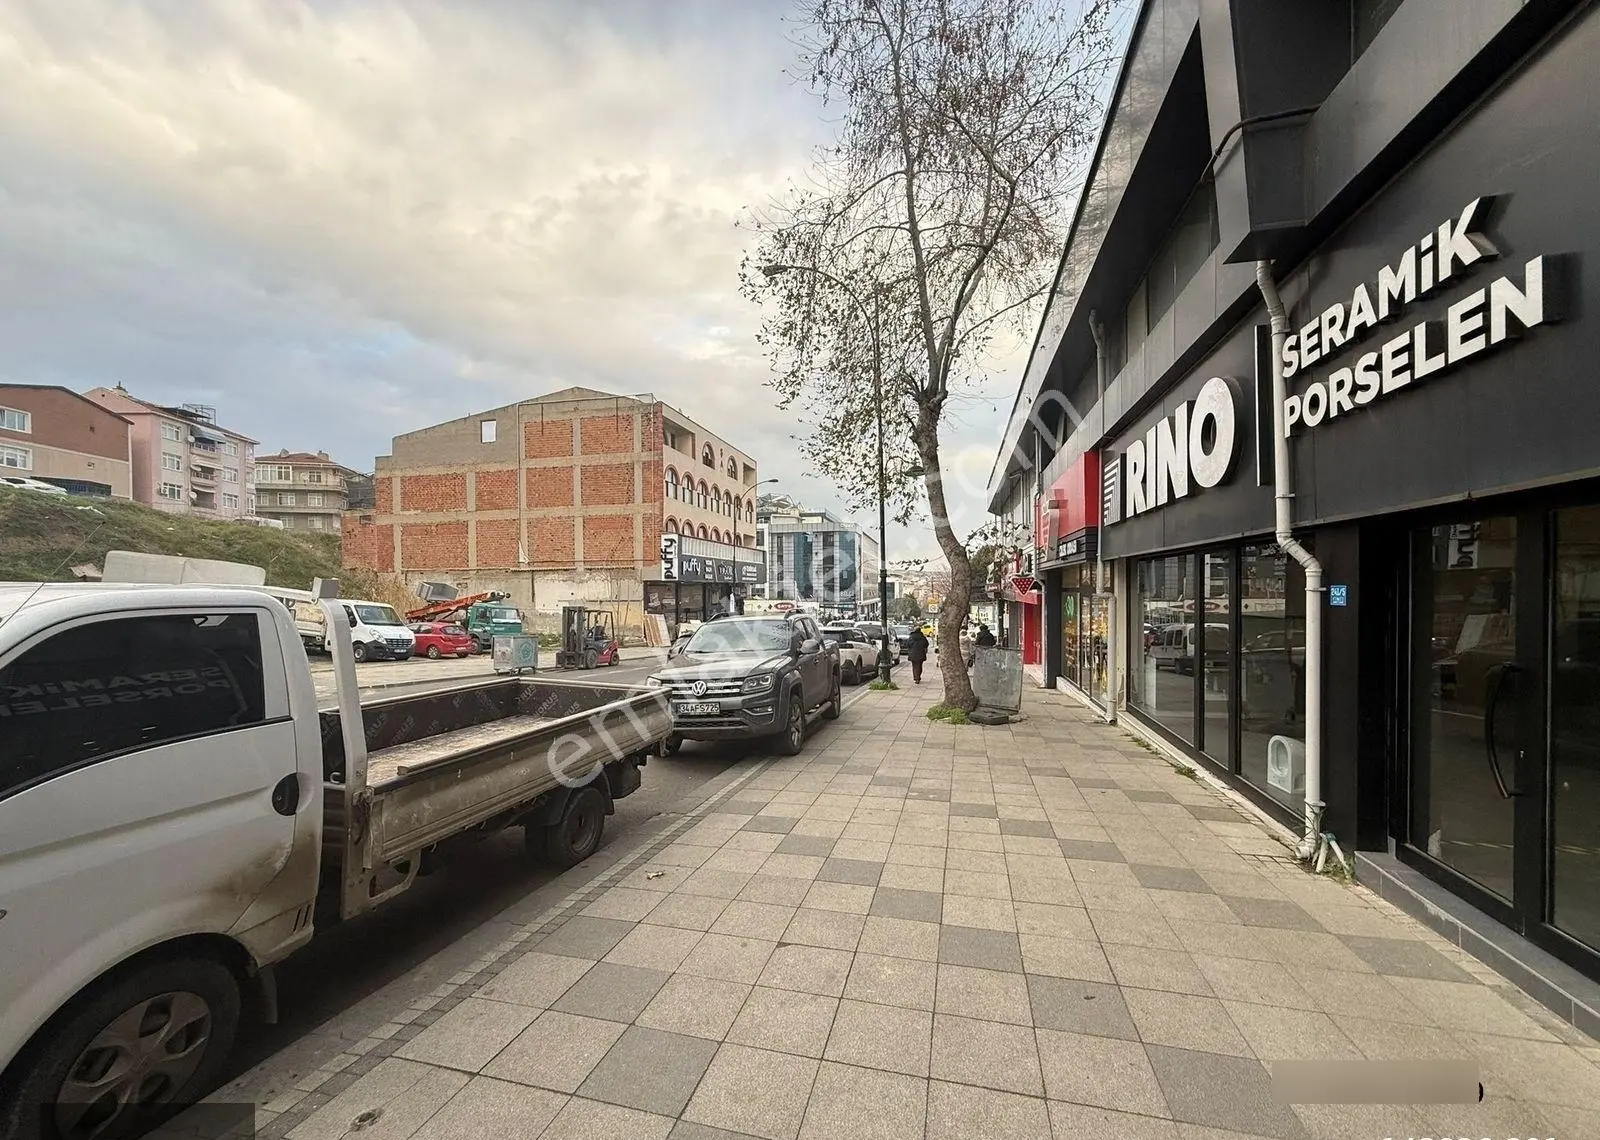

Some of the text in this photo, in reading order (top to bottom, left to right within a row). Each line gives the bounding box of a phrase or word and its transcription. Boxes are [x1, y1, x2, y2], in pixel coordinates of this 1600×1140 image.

[1283, 254, 1544, 439] PORSELEN
[1125, 376, 1236, 519] RINO
[661, 538, 677, 580] puffy
[682, 558, 701, 575] puffy
